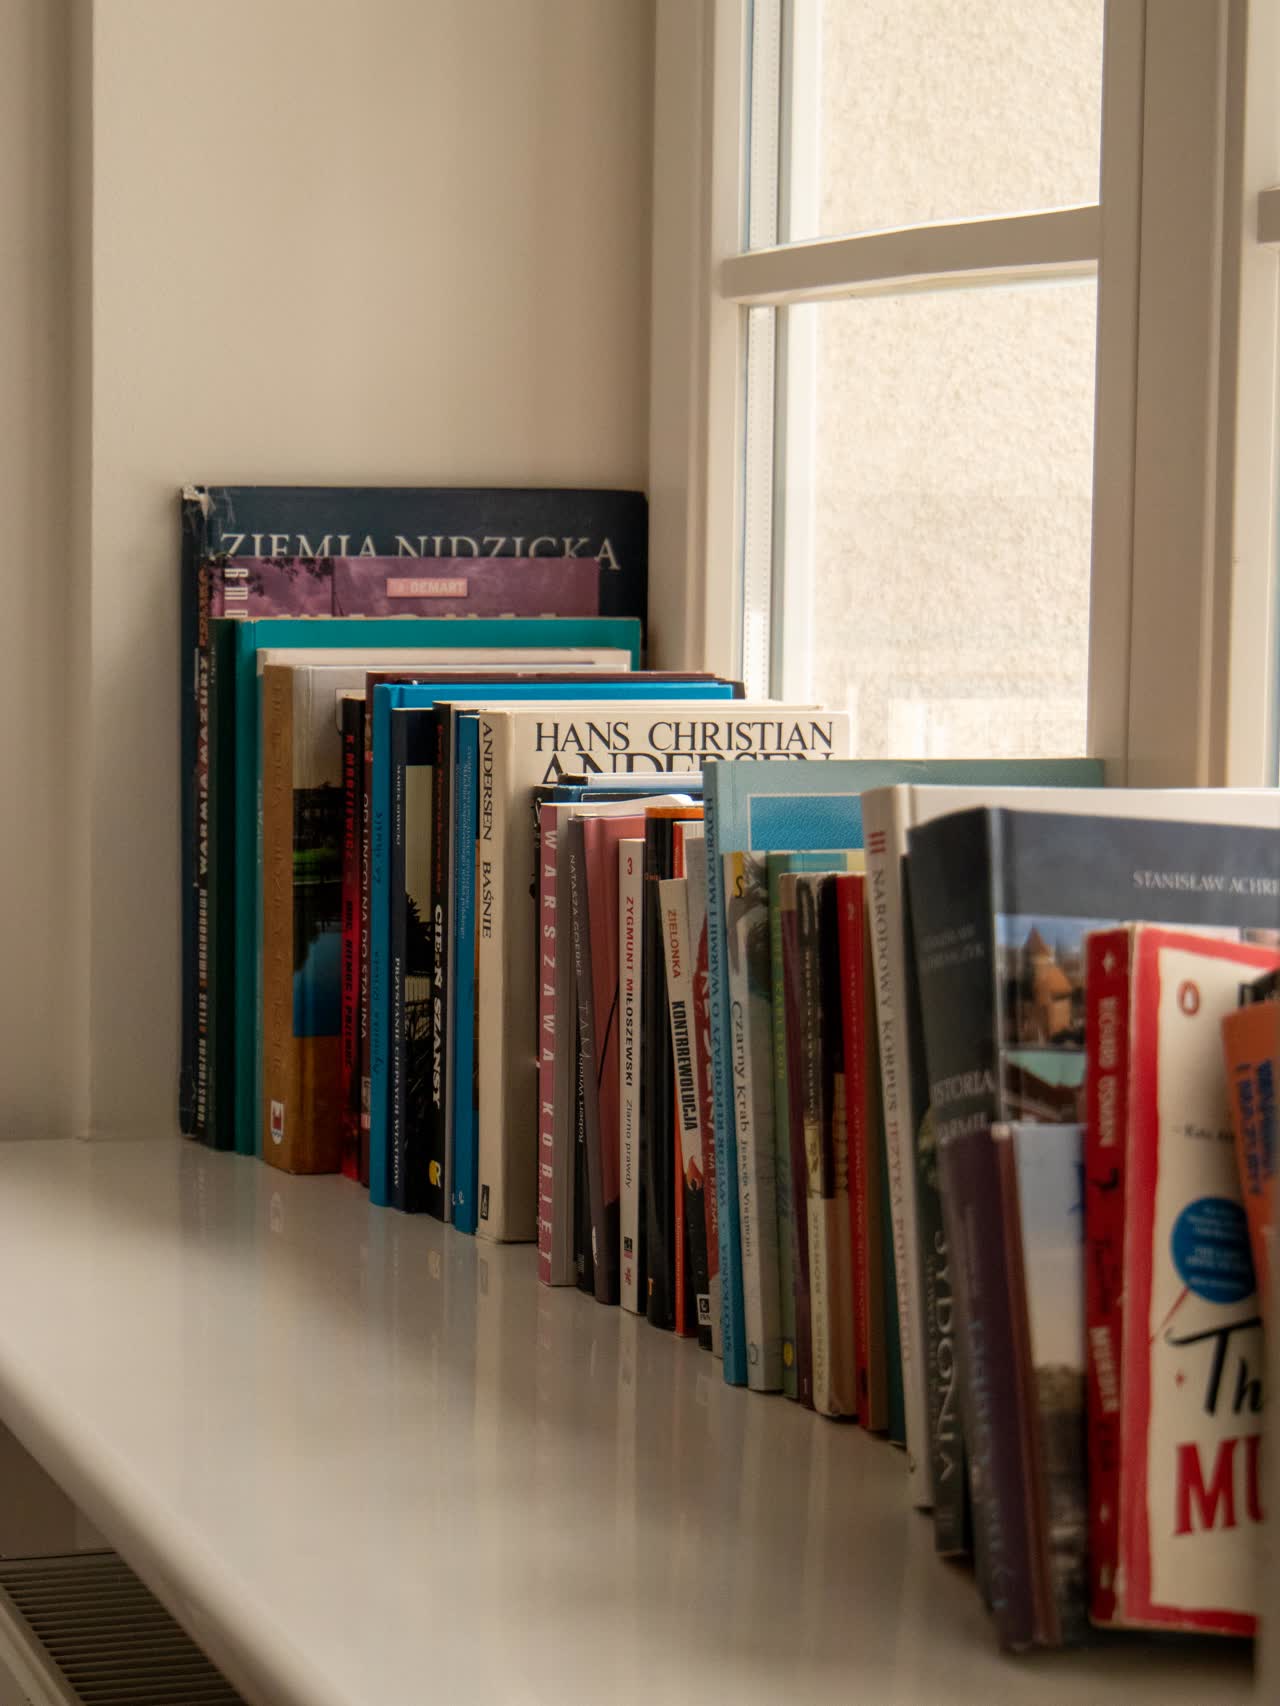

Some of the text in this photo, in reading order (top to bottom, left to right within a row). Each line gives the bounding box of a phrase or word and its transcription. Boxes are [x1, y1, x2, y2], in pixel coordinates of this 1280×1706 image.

[220, 533, 621, 571] ZIEMIA NIDZICKA
[535, 721, 833, 752] HANS CHRISTIAN
[482, 722, 494, 939] ANDERSEN BAŚNIE
[705, 796, 716, 904] MAZURACH
[867, 831, 886, 854] III
[570, 854, 580, 915] NATASZA
[1133, 869, 1224, 892] STANISŁAW
[394, 957, 402, 1041] PRZYSTANIE
[709, 924, 720, 997] WARMII
[433, 995, 442, 1109] SZANSY
[541, 829, 557, 1263] WARSZAWA KOBIET
[624, 896, 635, 1188] ZYGMUNT MIŁOSZEWSKI Ziarno prawdy
[668, 909, 698, 1131] ZIELONKA KONTRREWOLUCJA
[732, 1000, 747, 1078] Czarny
[577, 1103, 585, 1144] Robert
[737, 1085, 751, 1132] Krab
[872, 869, 912, 1361] NARODOWY KORPUS JĘZYKA POLSKIEGO
